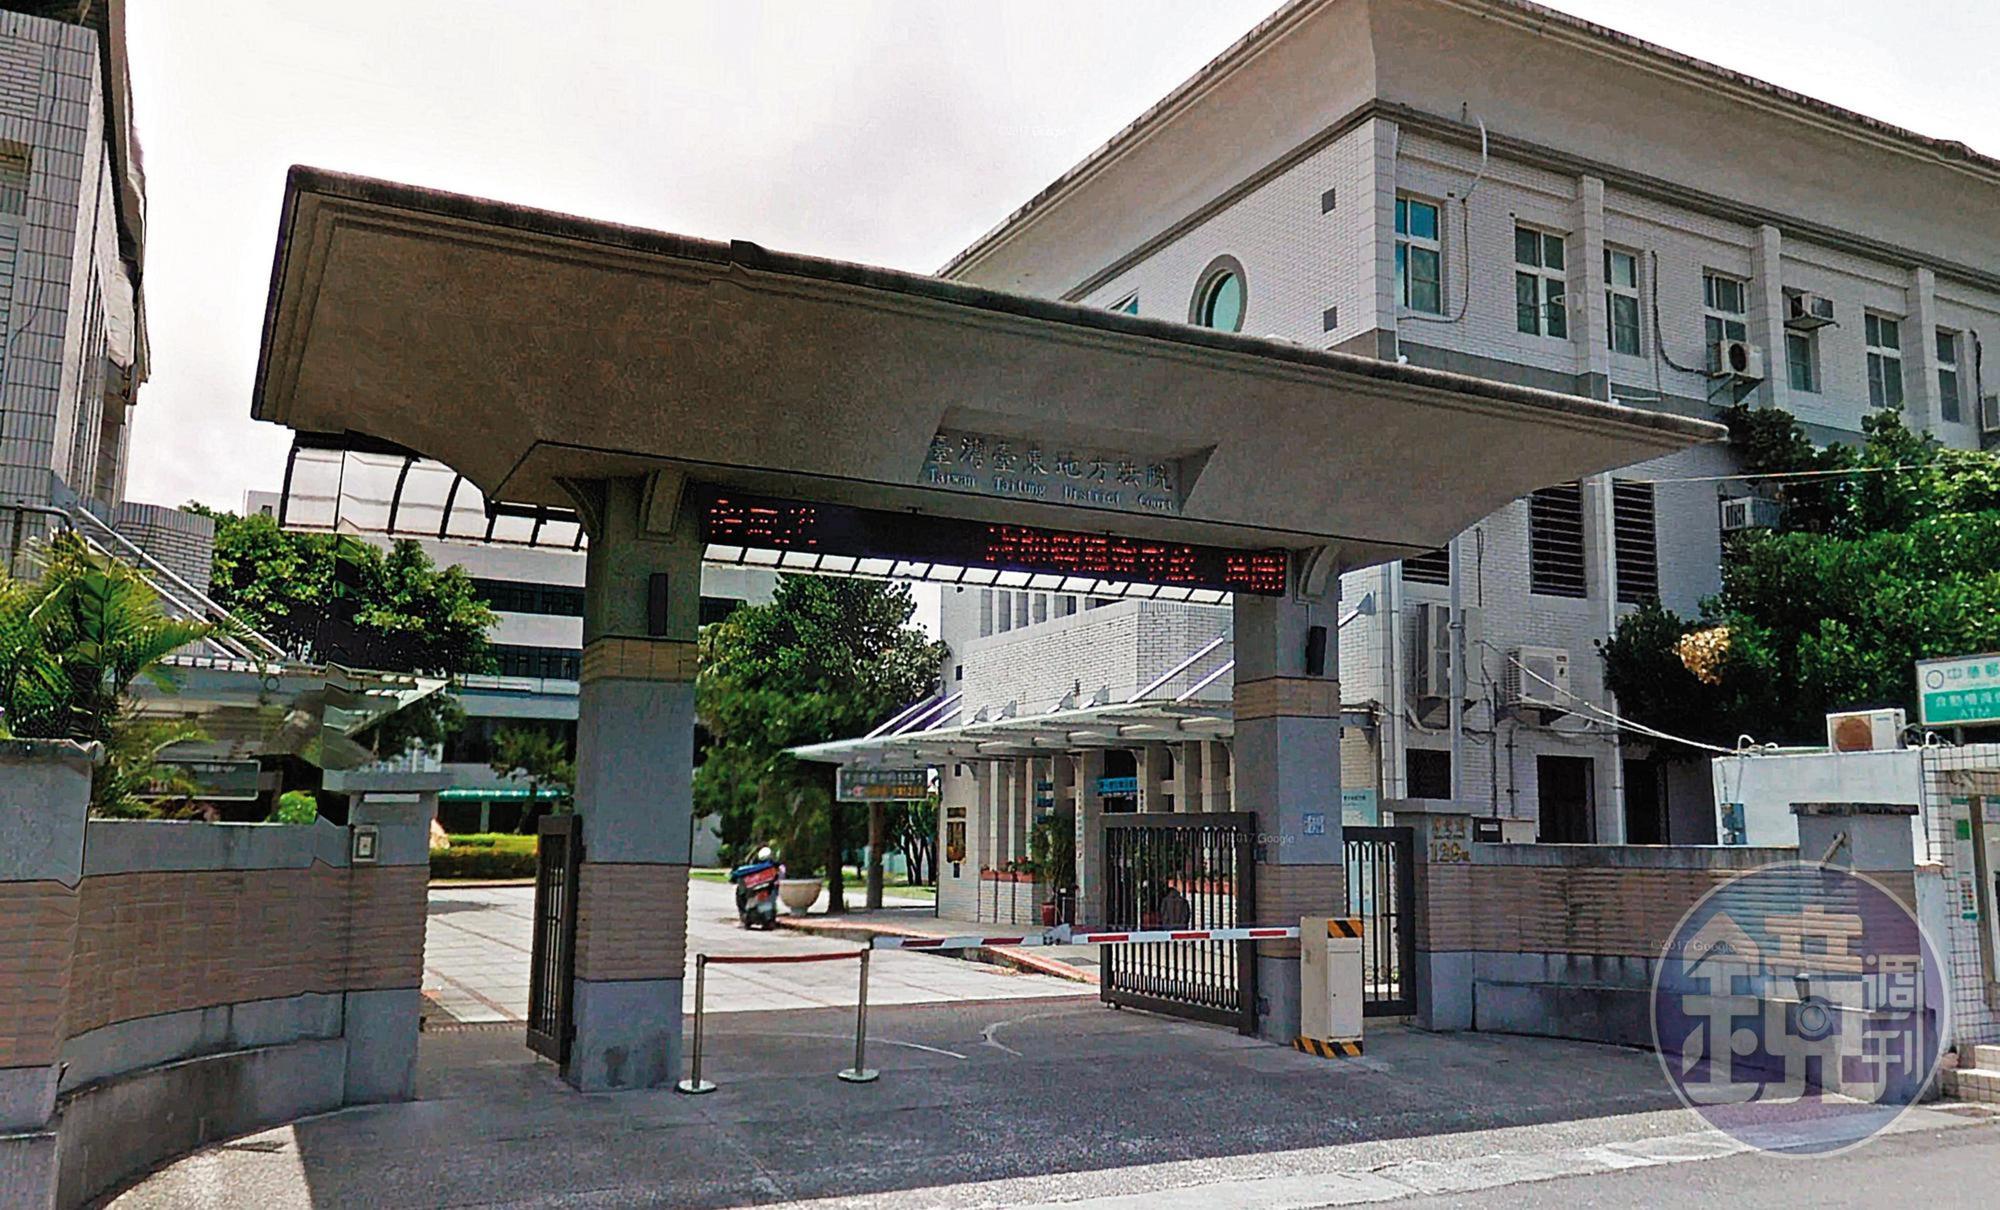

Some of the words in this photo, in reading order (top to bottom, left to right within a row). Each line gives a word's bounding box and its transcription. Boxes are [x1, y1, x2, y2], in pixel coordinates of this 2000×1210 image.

[929, 433, 1174, 493] 臺灣臺東地方法院
[929, 467, 976, 488] Taiwan
[994, 476, 1047, 497] Taitung
[1064, 486, 1120, 506] District
[1138, 495, 1174, 511] Court
